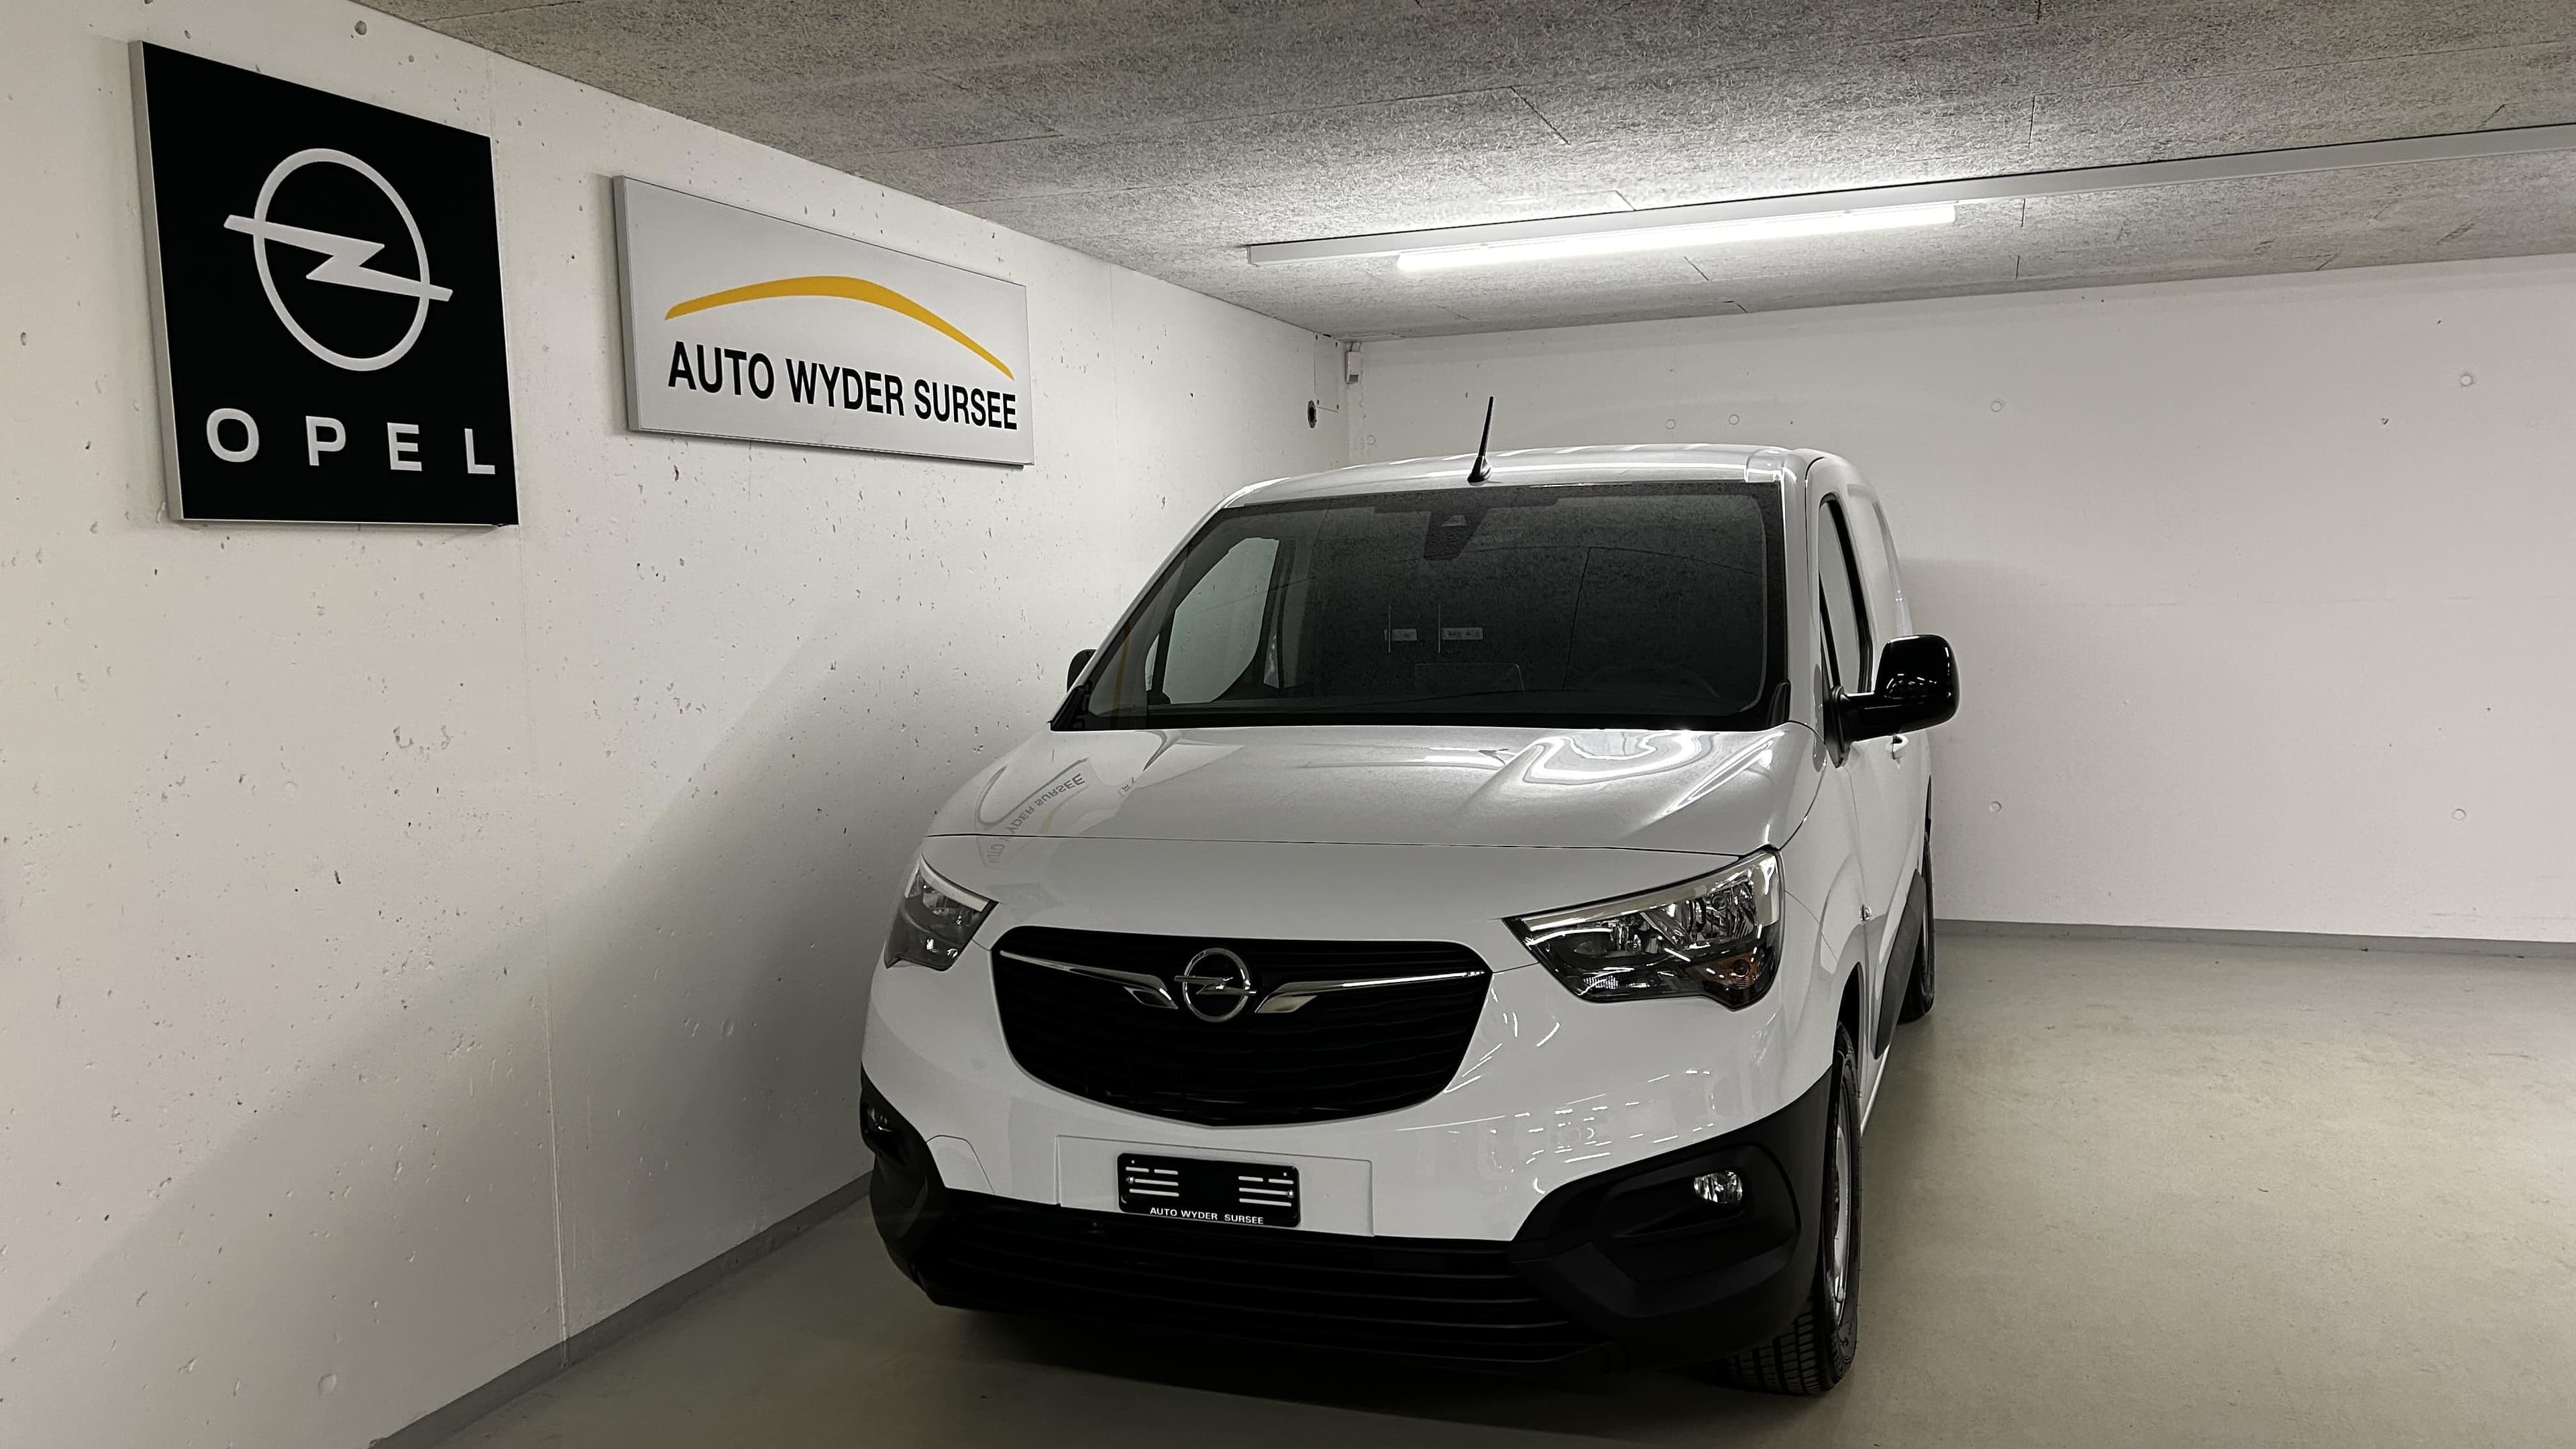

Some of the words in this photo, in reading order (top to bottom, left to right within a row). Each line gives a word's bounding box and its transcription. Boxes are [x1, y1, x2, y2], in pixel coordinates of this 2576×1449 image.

[667, 341, 774, 400] AUTO
[785, 358, 905, 417] WYDER
[914, 379, 1018, 431] SURSEE
[205, 407, 496, 476] OPEL
[1149, 1207, 1177, 1217] AUTO
[1181, 1210, 1218, 1220] WYDER
[1224, 1214, 1264, 1224] SURSEE
